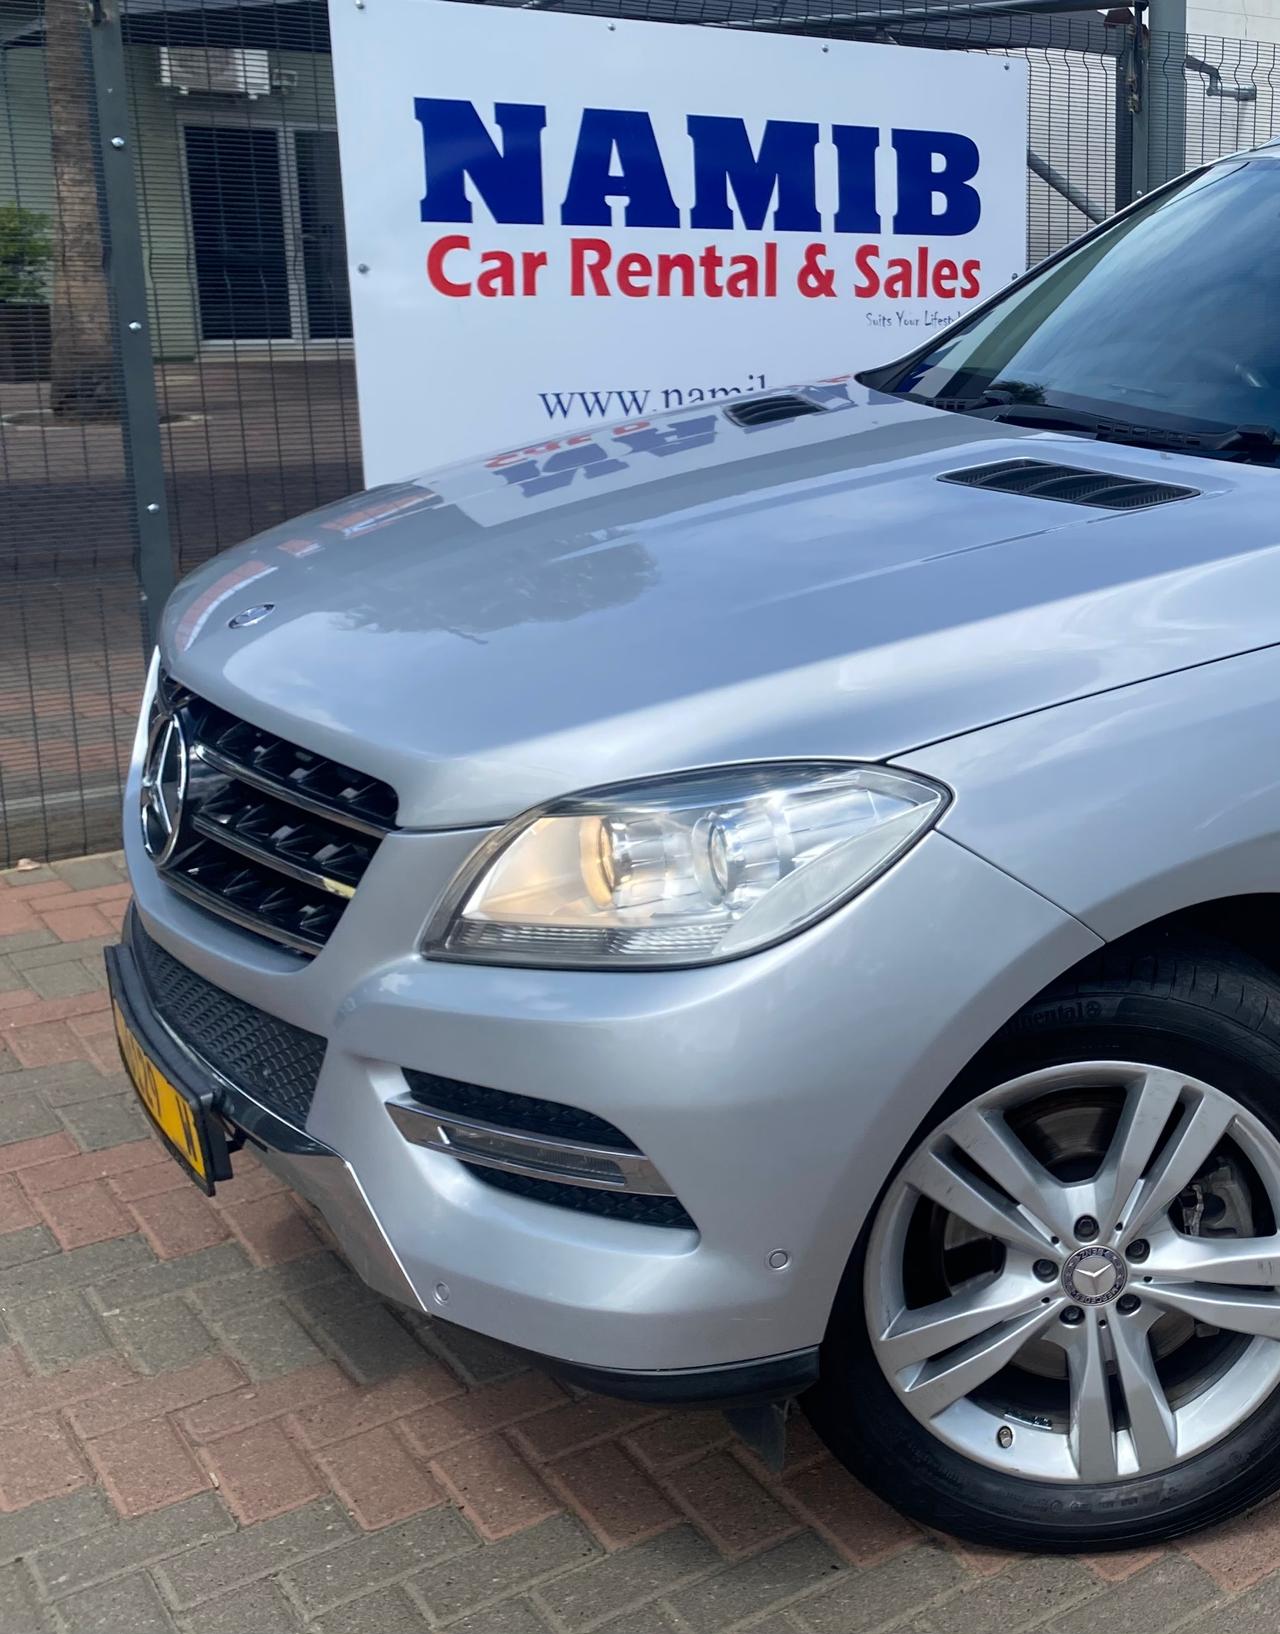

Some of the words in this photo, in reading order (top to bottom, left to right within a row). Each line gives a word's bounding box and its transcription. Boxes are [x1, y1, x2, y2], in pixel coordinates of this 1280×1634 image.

[412, 97, 981, 236] NAMIB
[426, 235, 548, 298] Car
[570, 238, 777, 299] Rental
[797, 243, 837, 299] &
[853, 244, 981, 300] Sales
[865, 311, 893, 327] Suits
[895, 310, 920, 327] Your
